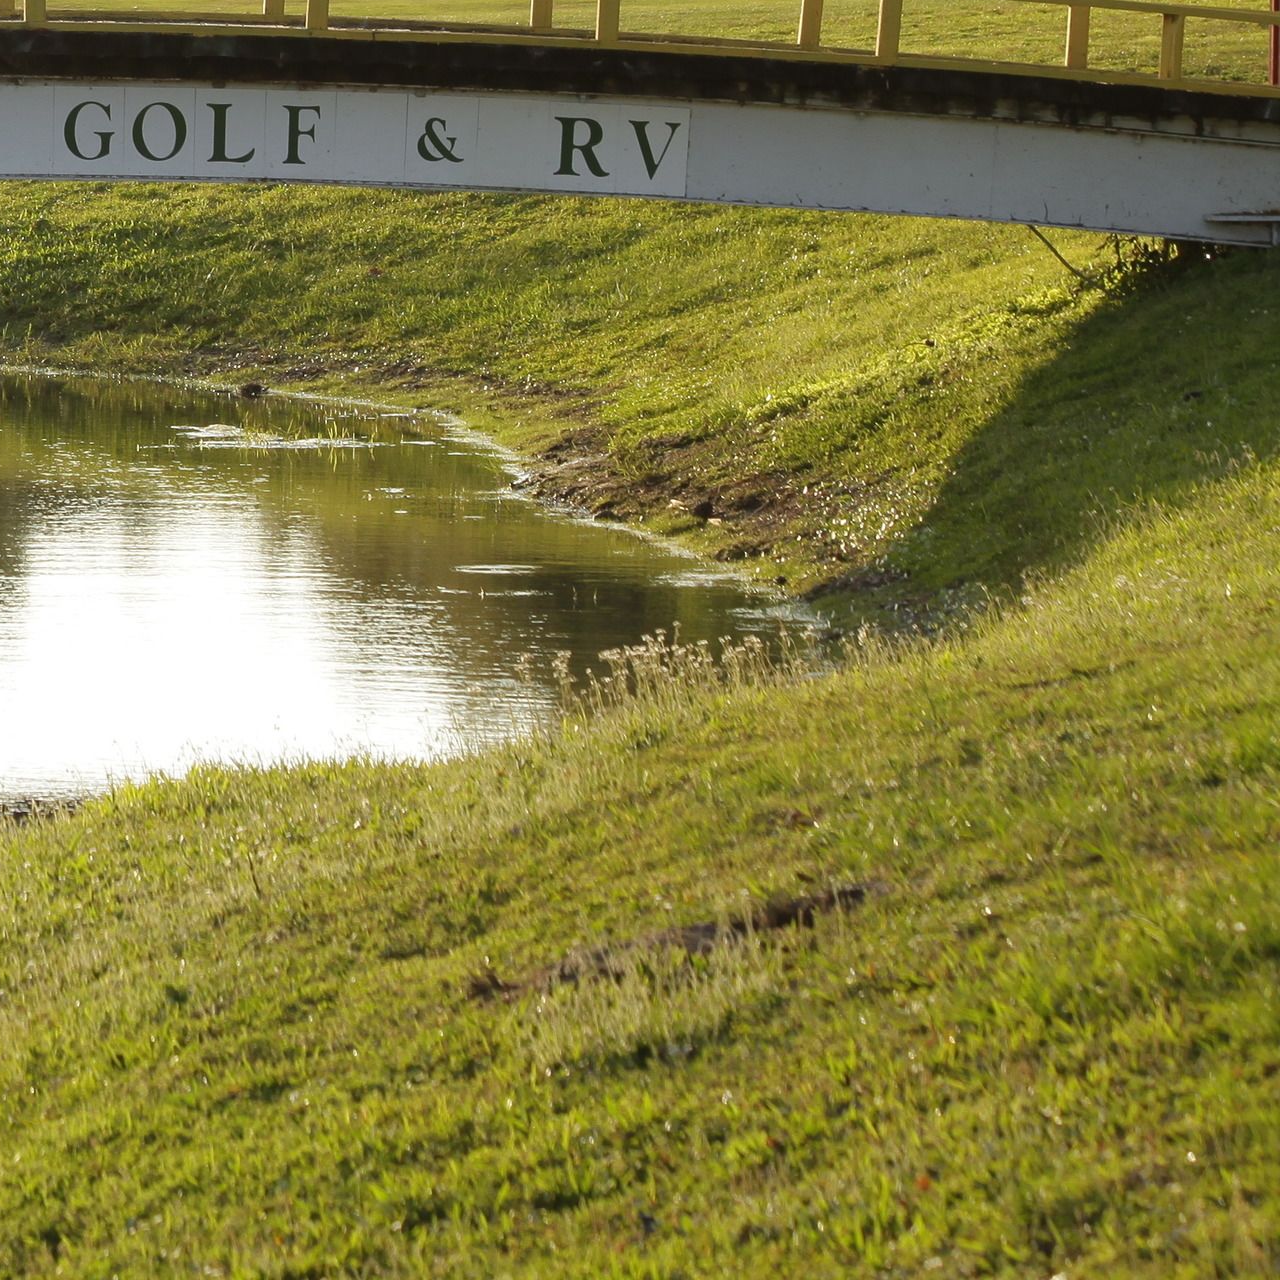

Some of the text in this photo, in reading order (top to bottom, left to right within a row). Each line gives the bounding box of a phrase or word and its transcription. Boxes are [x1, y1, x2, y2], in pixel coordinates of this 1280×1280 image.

[63, 100, 321, 165] GOLF
[416, 117, 466, 163] &
[553, 116, 682, 180] RV
